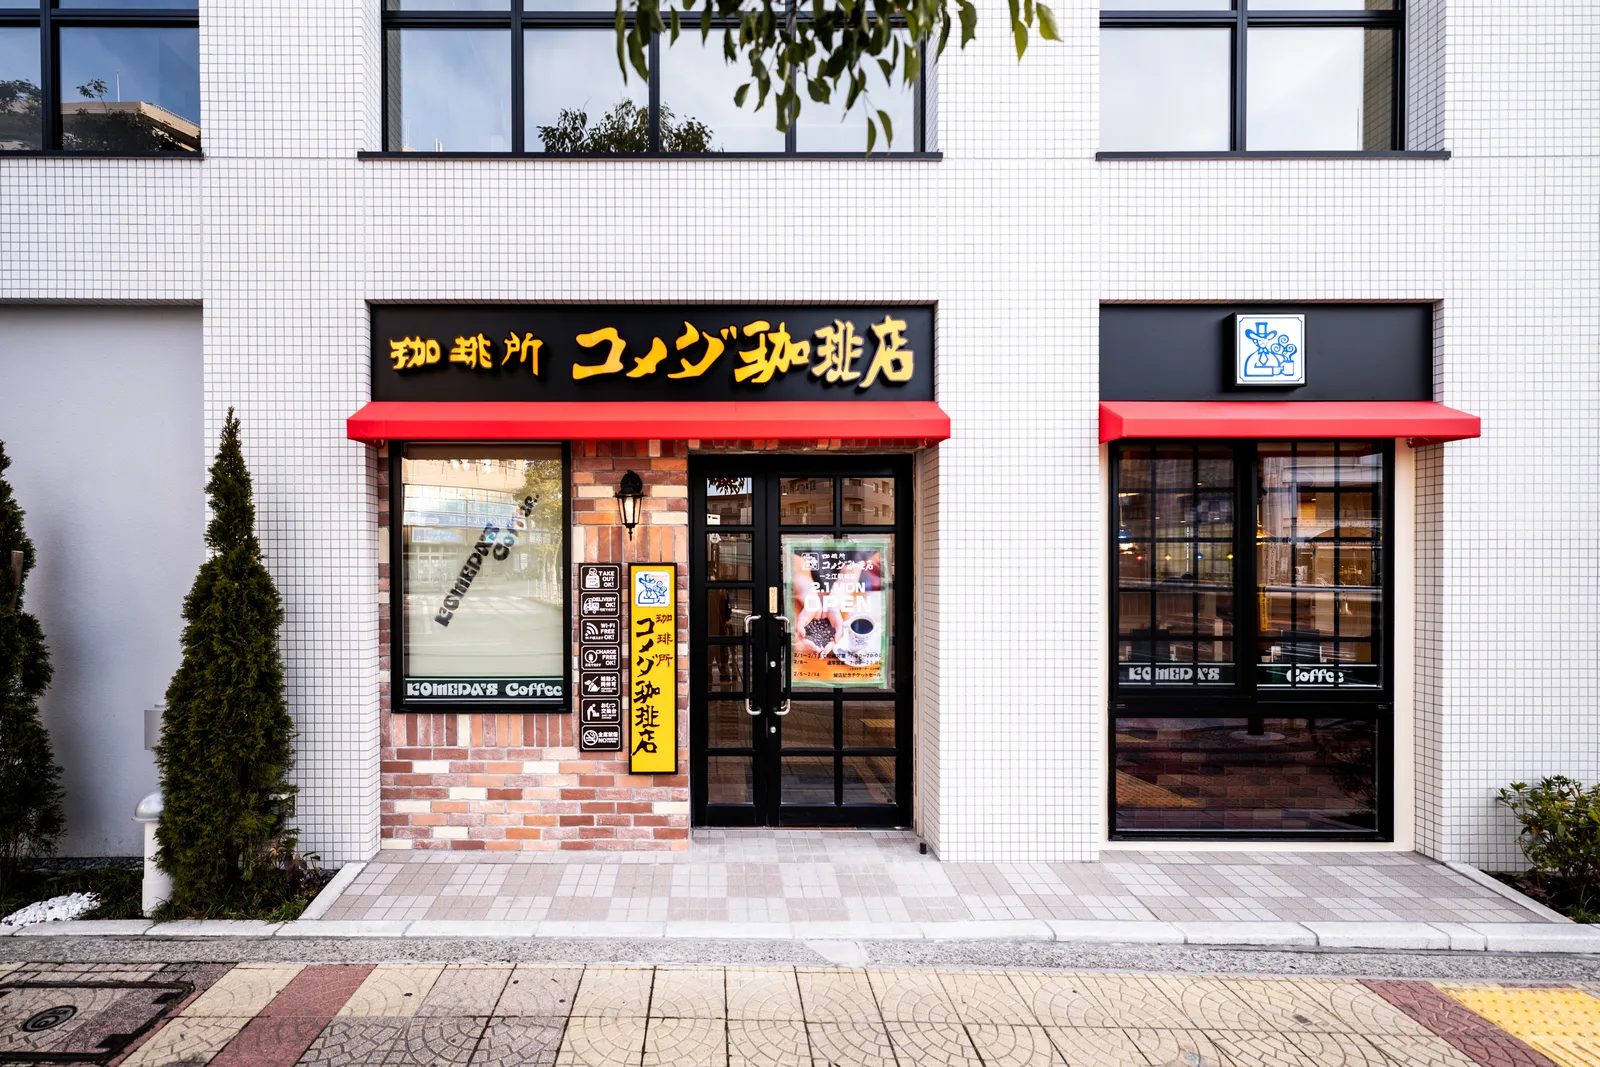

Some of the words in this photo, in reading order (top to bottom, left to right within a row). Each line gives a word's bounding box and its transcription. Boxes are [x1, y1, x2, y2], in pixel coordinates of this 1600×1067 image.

[389, 331, 544, 376] 珈琲所
[572, 315, 915, 388] コメダ珈琲店
[804, 595, 872, 613] OPEN
[655, 614, 674, 668] 珈琲所
[407, 682, 498, 697] KOMEDA'S
[505, 682, 563, 697] Coffee
[631, 617, 661, 756] コメダ珈琲店
